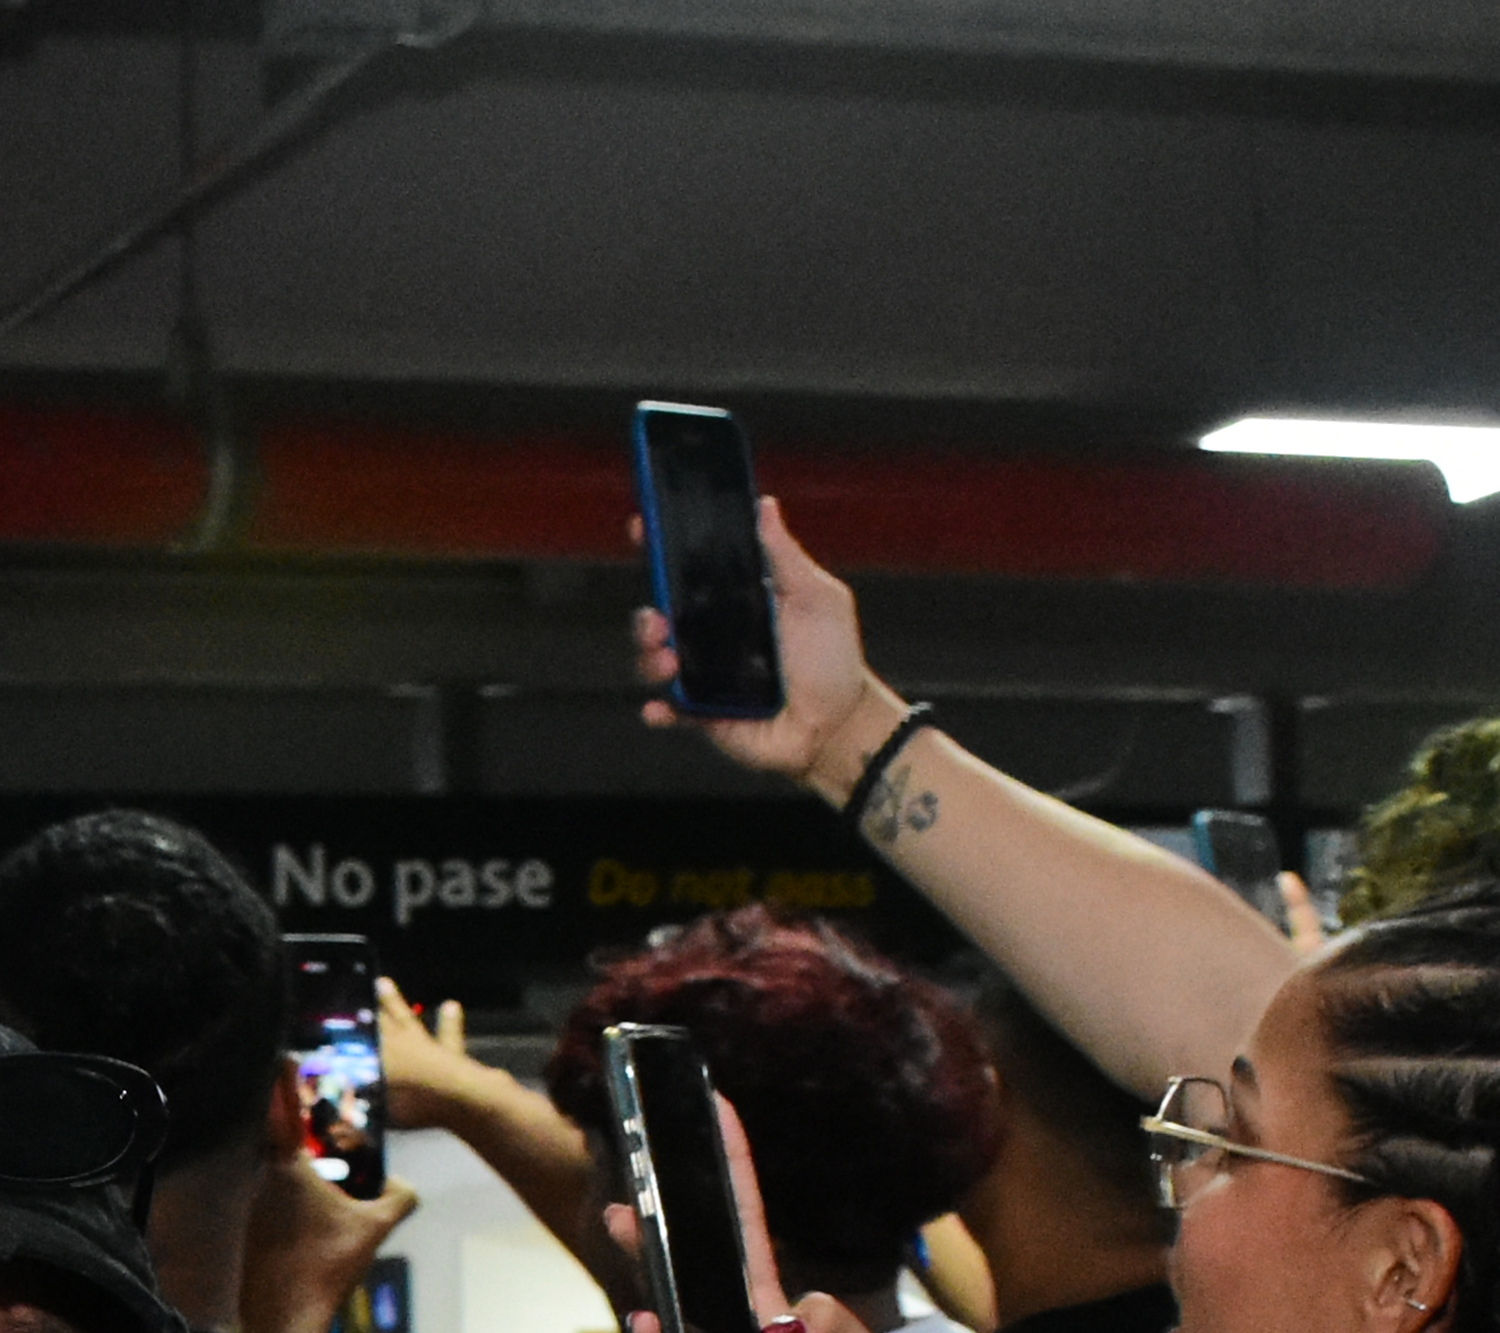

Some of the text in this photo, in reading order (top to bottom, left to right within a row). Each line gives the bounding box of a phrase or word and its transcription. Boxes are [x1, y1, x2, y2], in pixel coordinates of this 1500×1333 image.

[271, 842, 556, 928] No pase
[588, 857, 658, 907] Do
